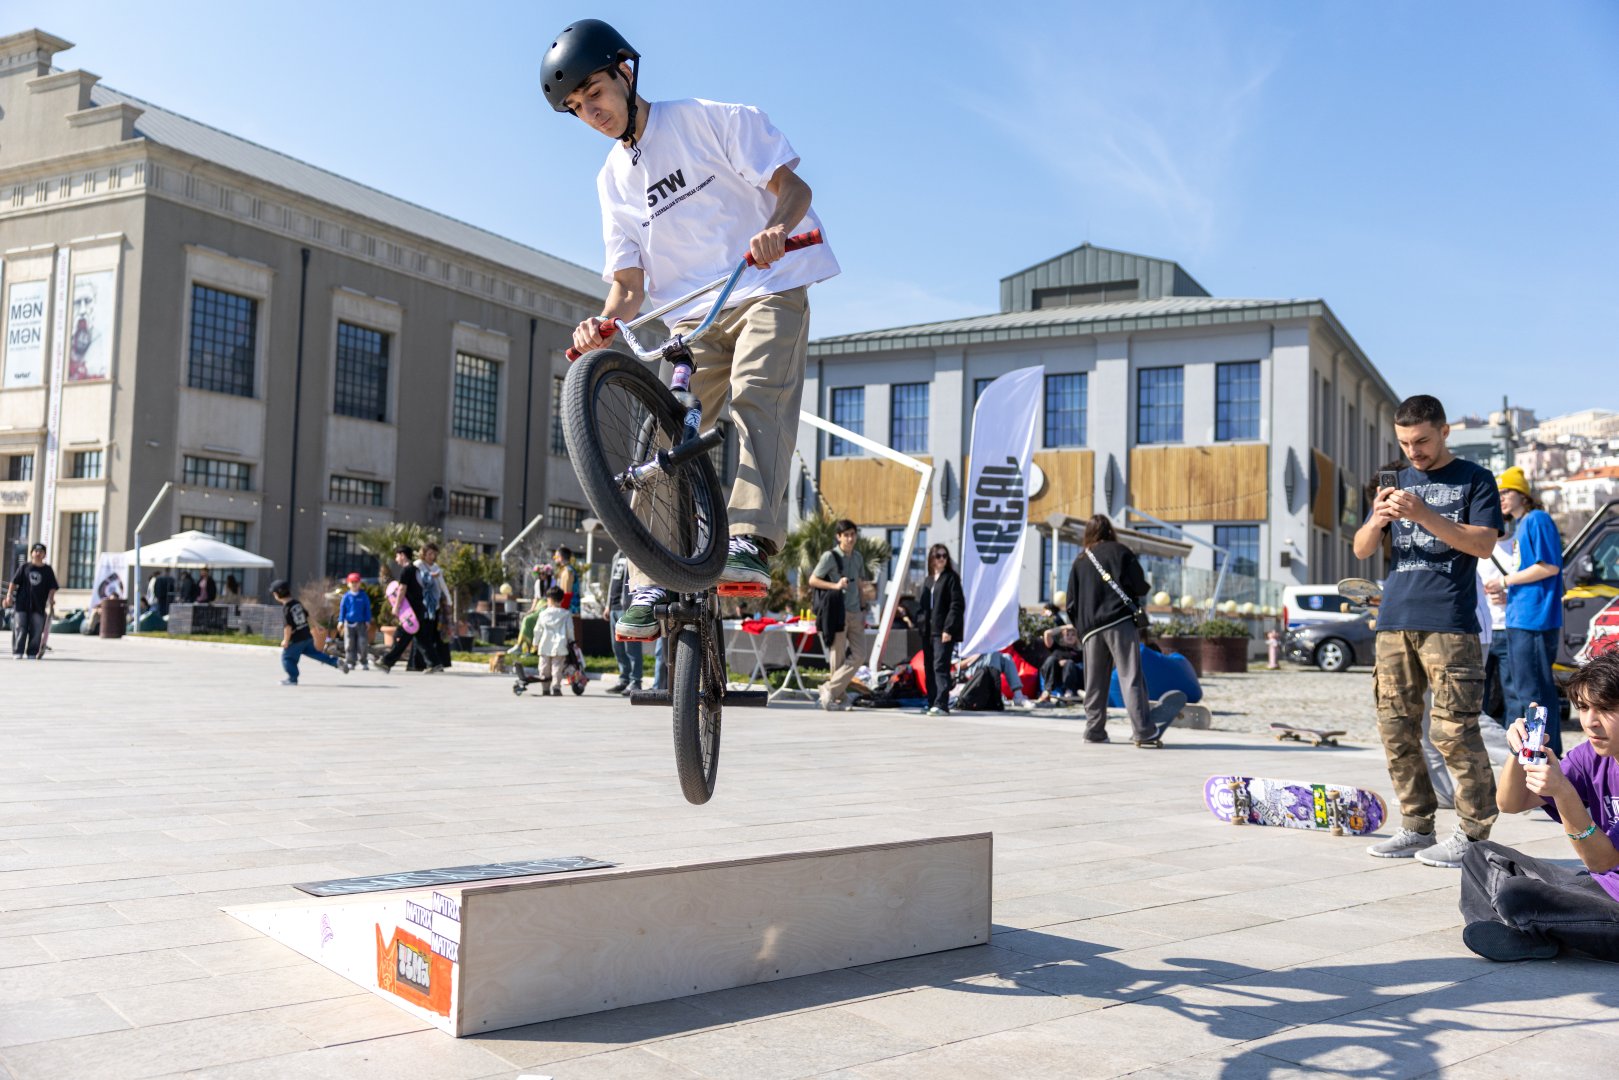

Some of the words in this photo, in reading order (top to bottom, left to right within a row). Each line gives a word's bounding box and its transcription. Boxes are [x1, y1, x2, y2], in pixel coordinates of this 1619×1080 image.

[647, 169, 686, 208] STW
[674, 188, 696, 204] STREETWEAR
[696, 174, 716, 192] COMMUNITY
[10, 302, 43, 320] MƏN
[9, 326, 42, 345] MƏN
[406, 900, 432, 930] MATRIX
[433, 892, 460, 922] MATRIX
[432, 932, 459, 963] MATRIX
